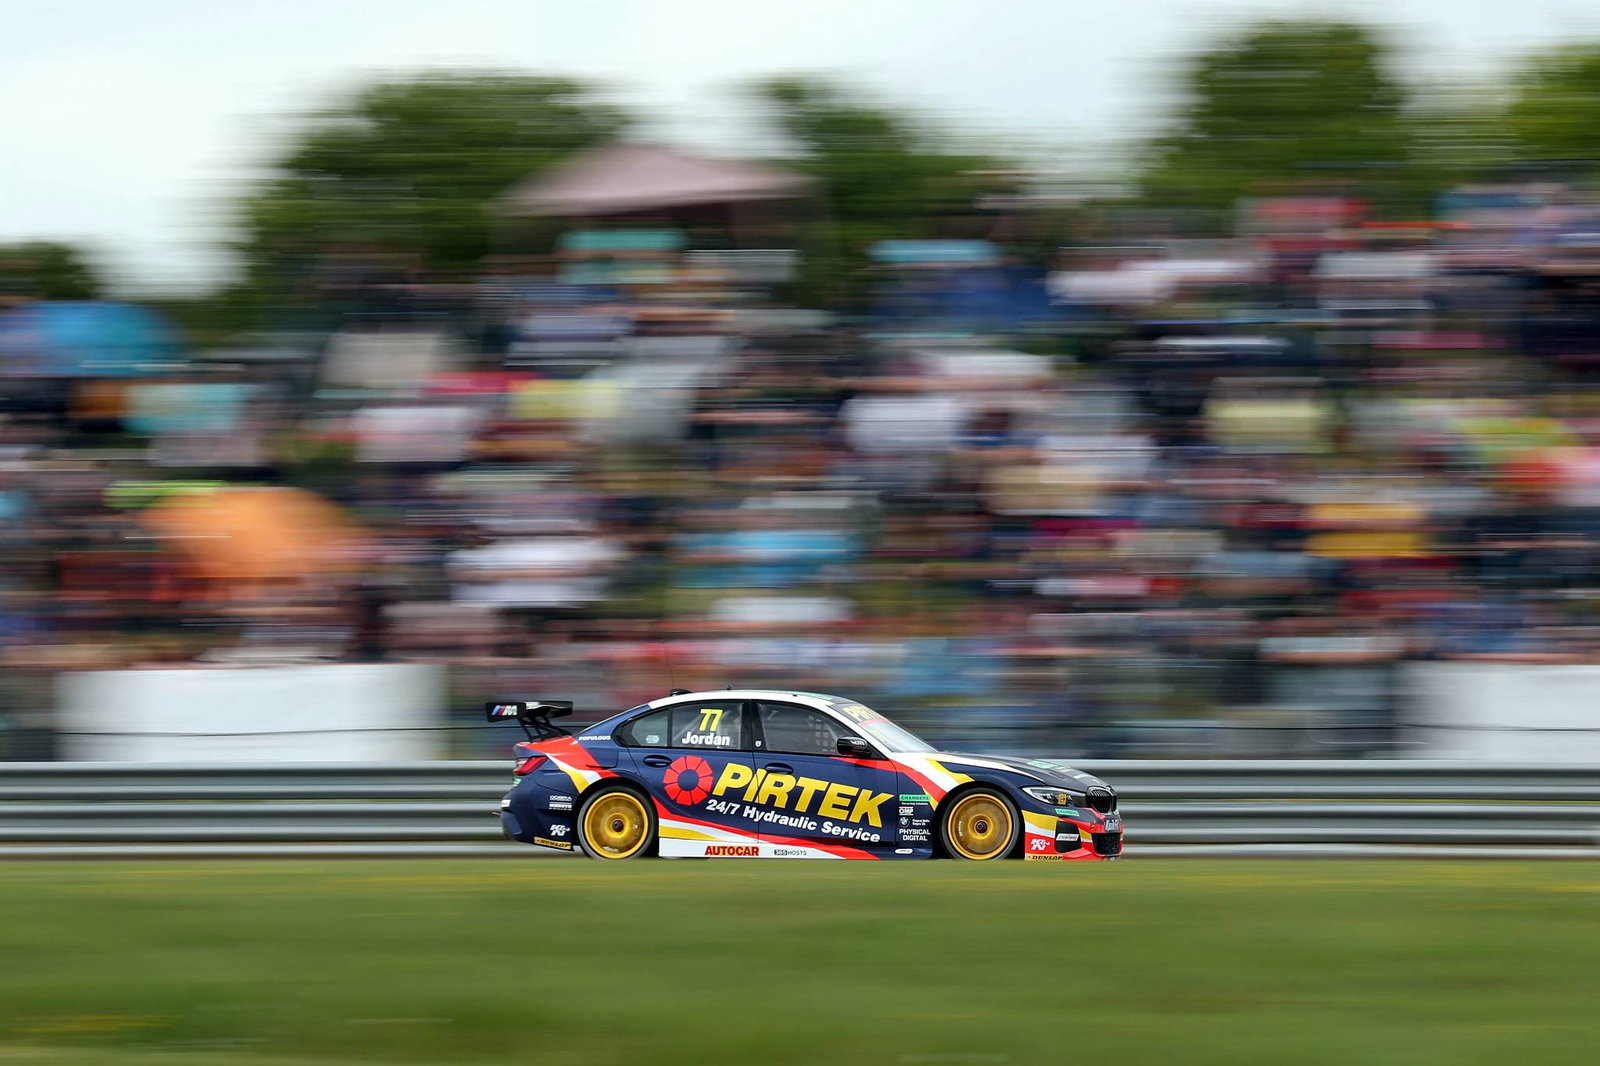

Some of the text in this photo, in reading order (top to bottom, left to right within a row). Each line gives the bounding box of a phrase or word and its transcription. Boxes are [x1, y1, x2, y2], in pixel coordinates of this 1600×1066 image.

[699, 708, 724, 732] 77
[681, 731, 731, 746] Jordan
[712, 762, 895, 828] PIRTEK
[899, 807, 914, 815] OMP
[705, 799, 881, 843] 24/7 Hydraulic Service
[538, 839, 571, 849] DUNLOP
[704, 845, 760, 857] AUTOCAR
